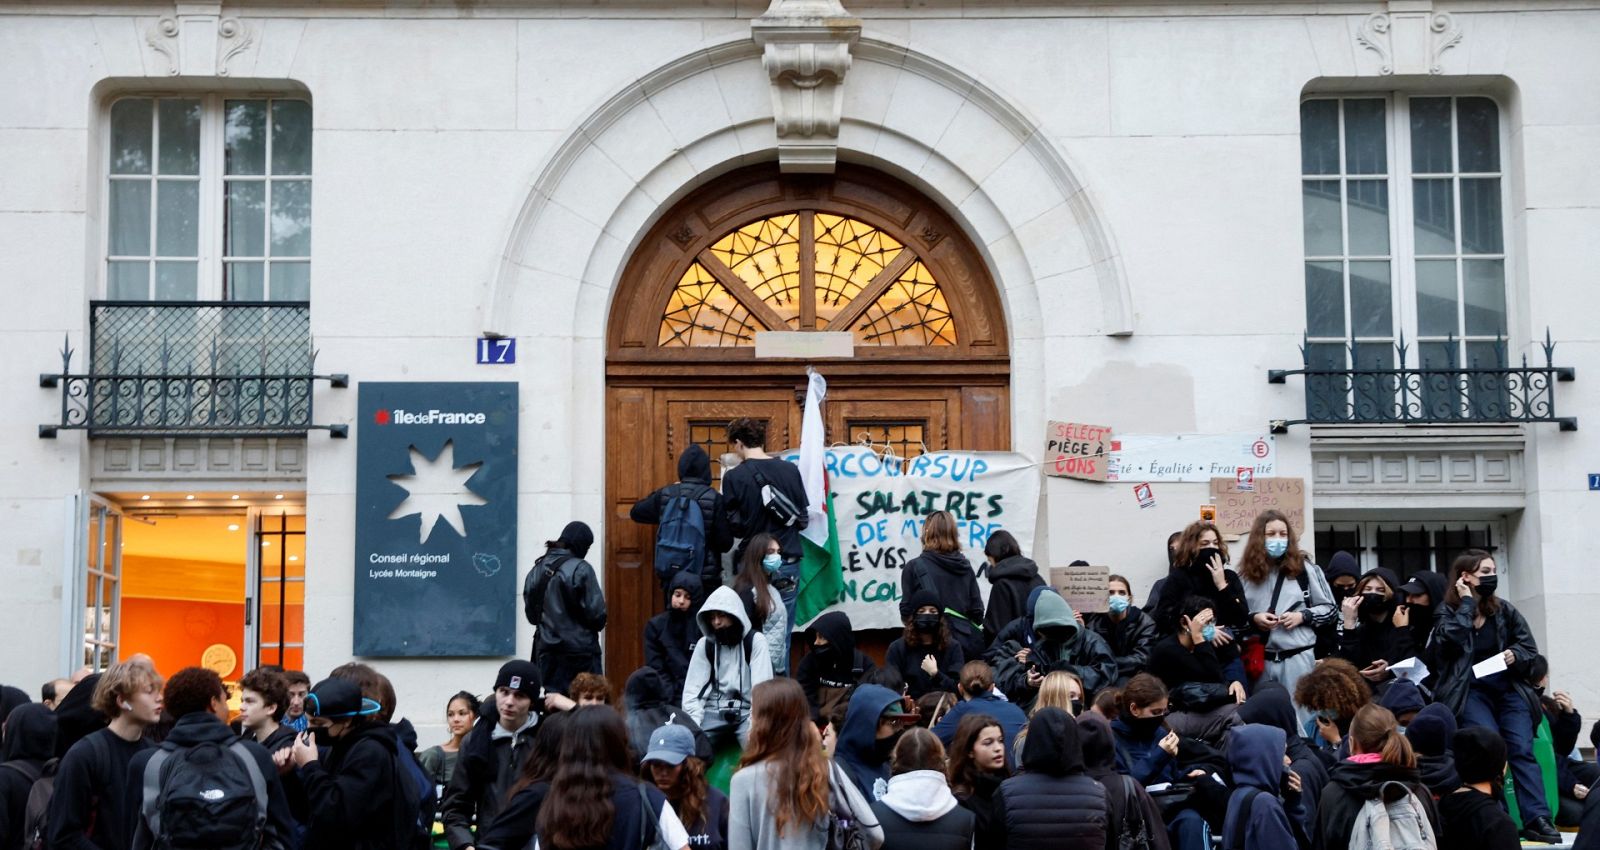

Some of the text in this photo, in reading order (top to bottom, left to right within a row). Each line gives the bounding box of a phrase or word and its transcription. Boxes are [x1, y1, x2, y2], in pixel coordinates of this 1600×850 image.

[481, 340, 511, 362] 17
[1048, 438, 1104, 457] PIÈGE À
[1055, 455, 1096, 475] CONS
[1149, 460, 1272, 476] Égalité Fratité
[855, 490, 1003, 520] SALAIRES
[855, 519, 888, 547] DE
[369, 553, 450, 565] Conseil régional
[369, 569, 437, 579] Lycée Montaigne
